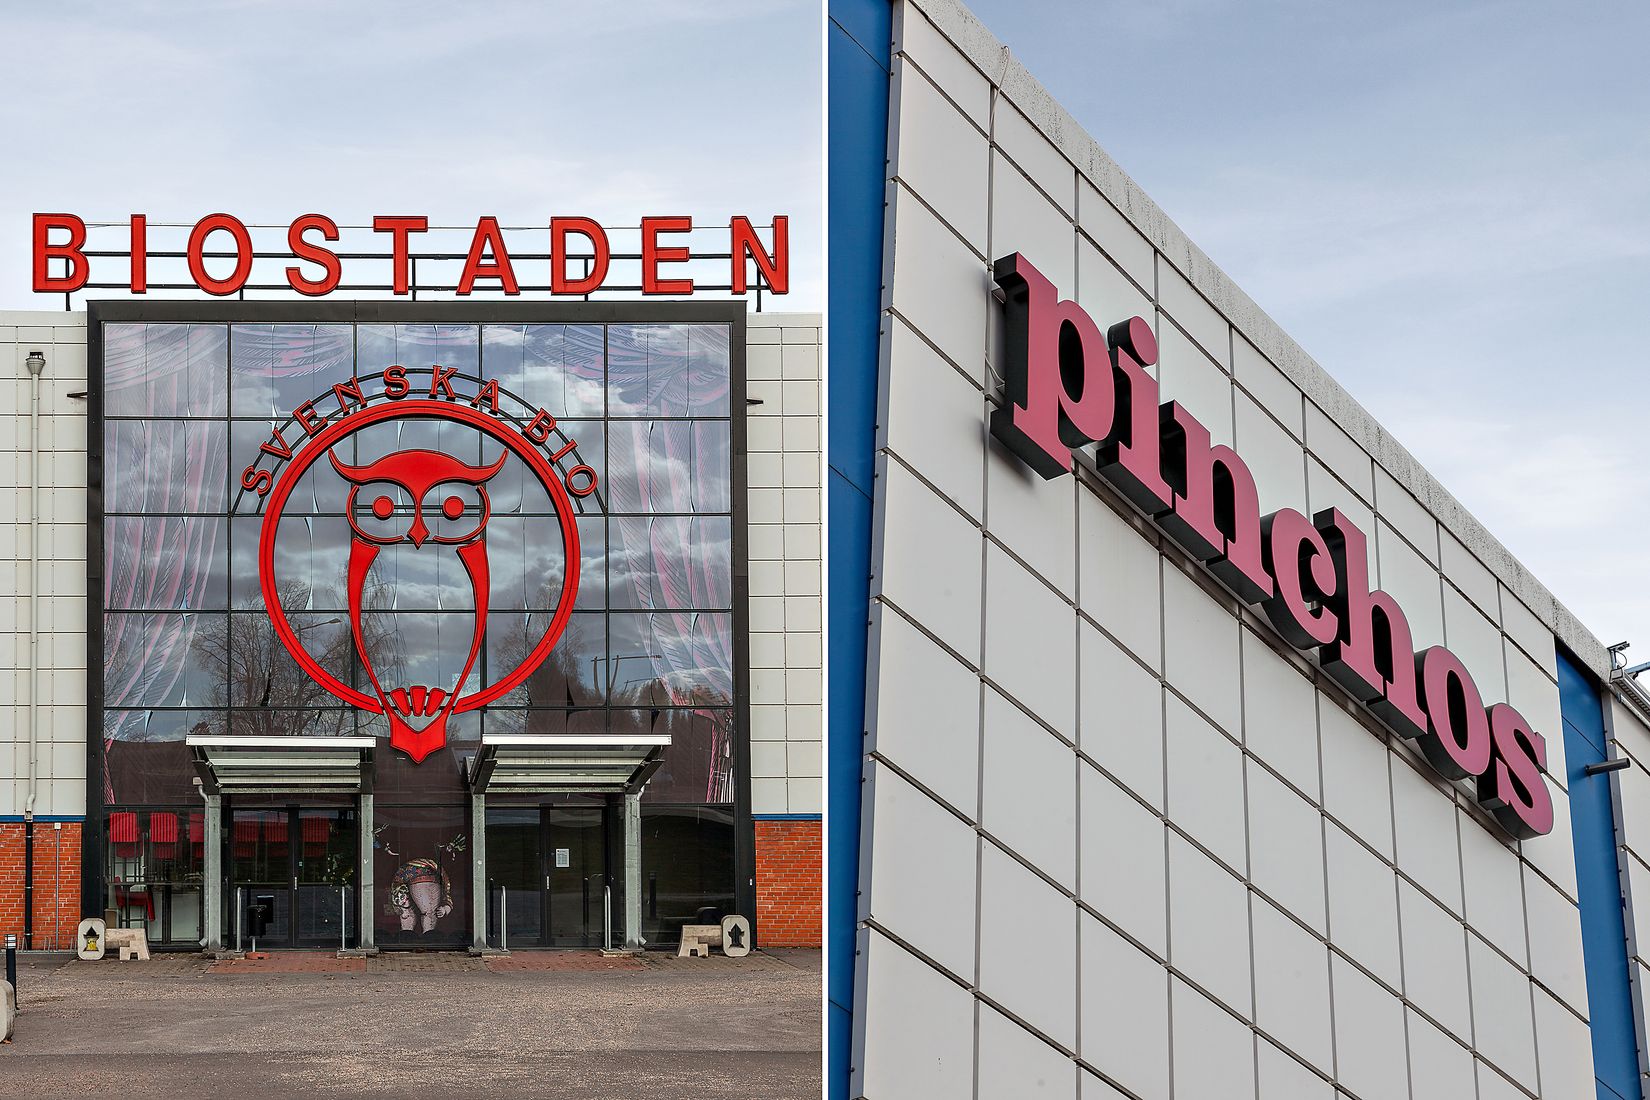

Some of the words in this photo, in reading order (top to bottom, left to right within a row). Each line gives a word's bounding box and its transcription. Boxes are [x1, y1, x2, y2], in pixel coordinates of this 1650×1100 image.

[32, 213, 789, 296] BIOSTADEN
[241, 365, 500, 496] SVENSKA
[522, 407, 598, 496] BIO
[1008, 252, 1554, 837] pinchos
